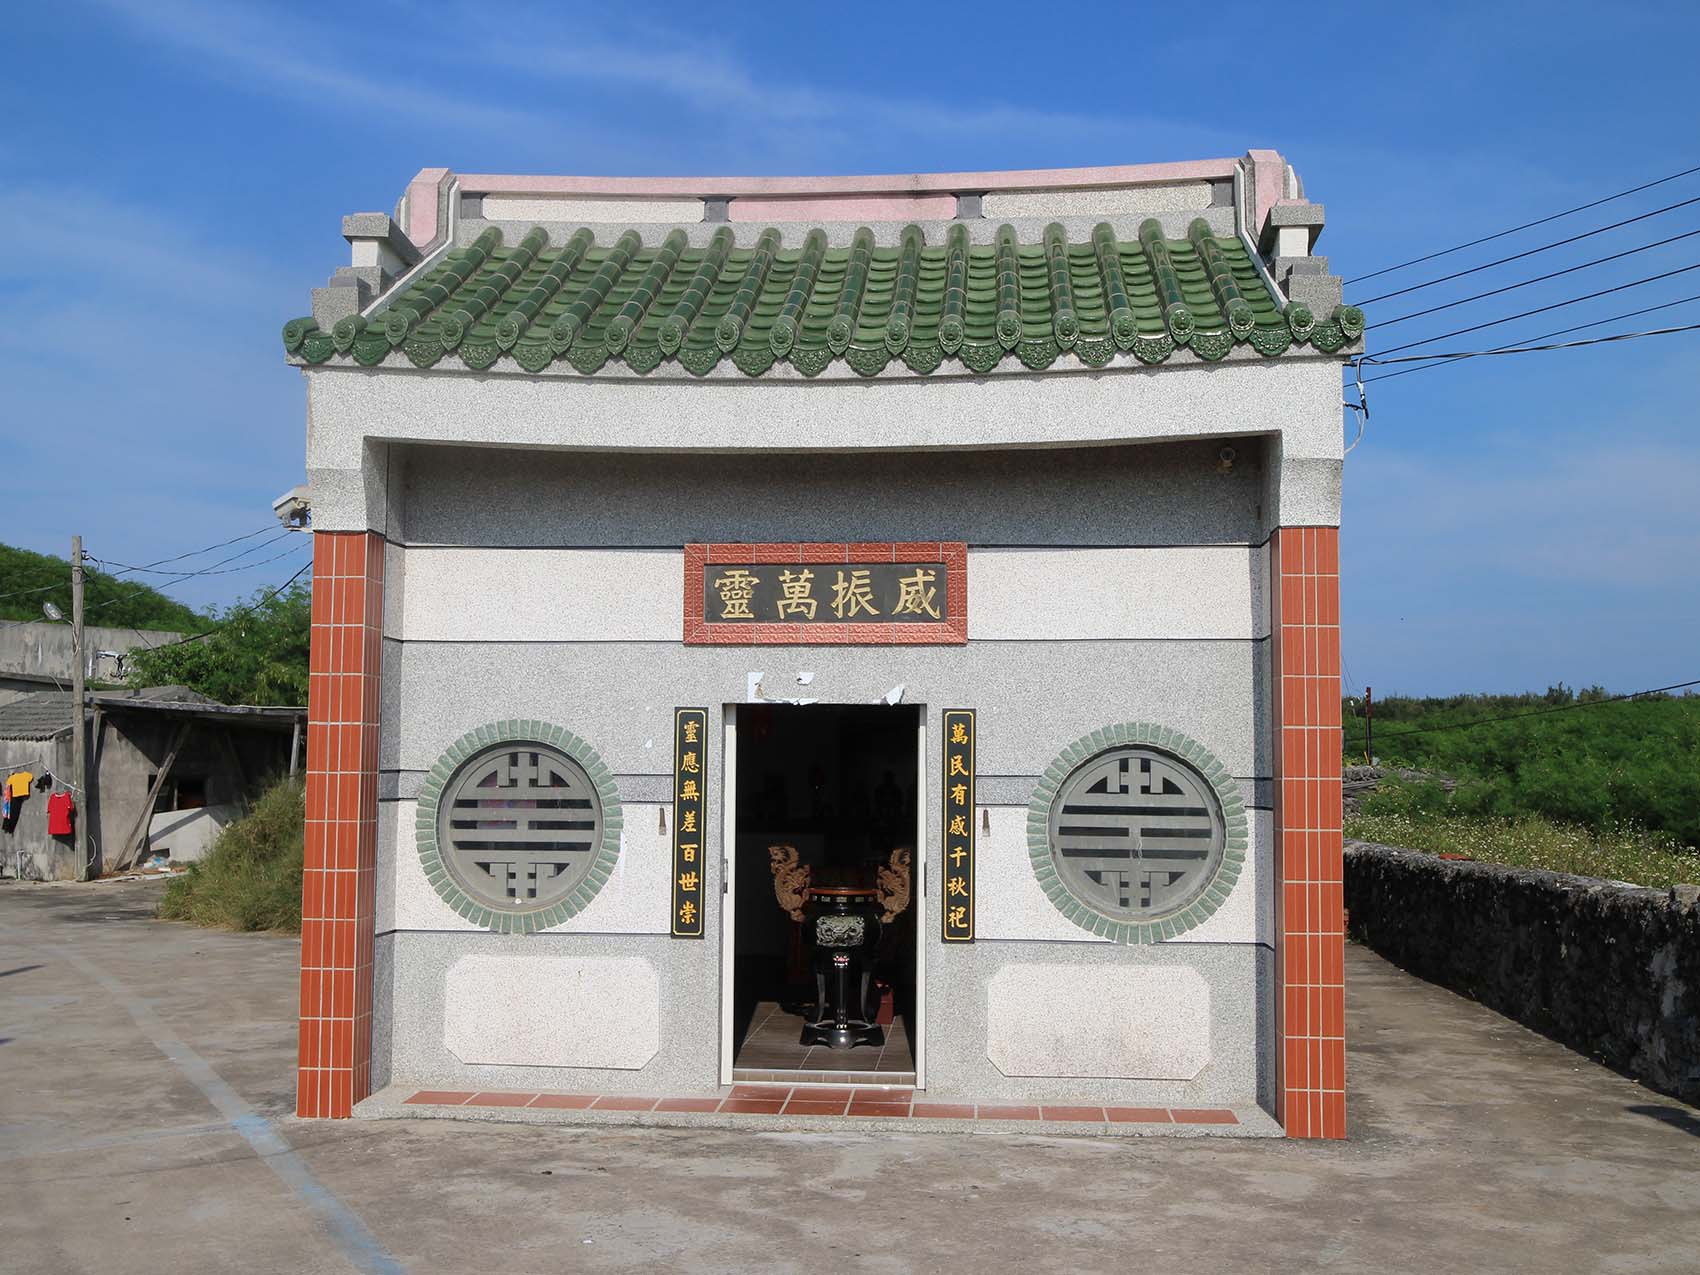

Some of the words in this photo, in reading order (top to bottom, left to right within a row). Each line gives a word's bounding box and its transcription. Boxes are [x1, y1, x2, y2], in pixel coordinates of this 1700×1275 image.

[947, 723, 969, 929] 萬民有感千秋祀
